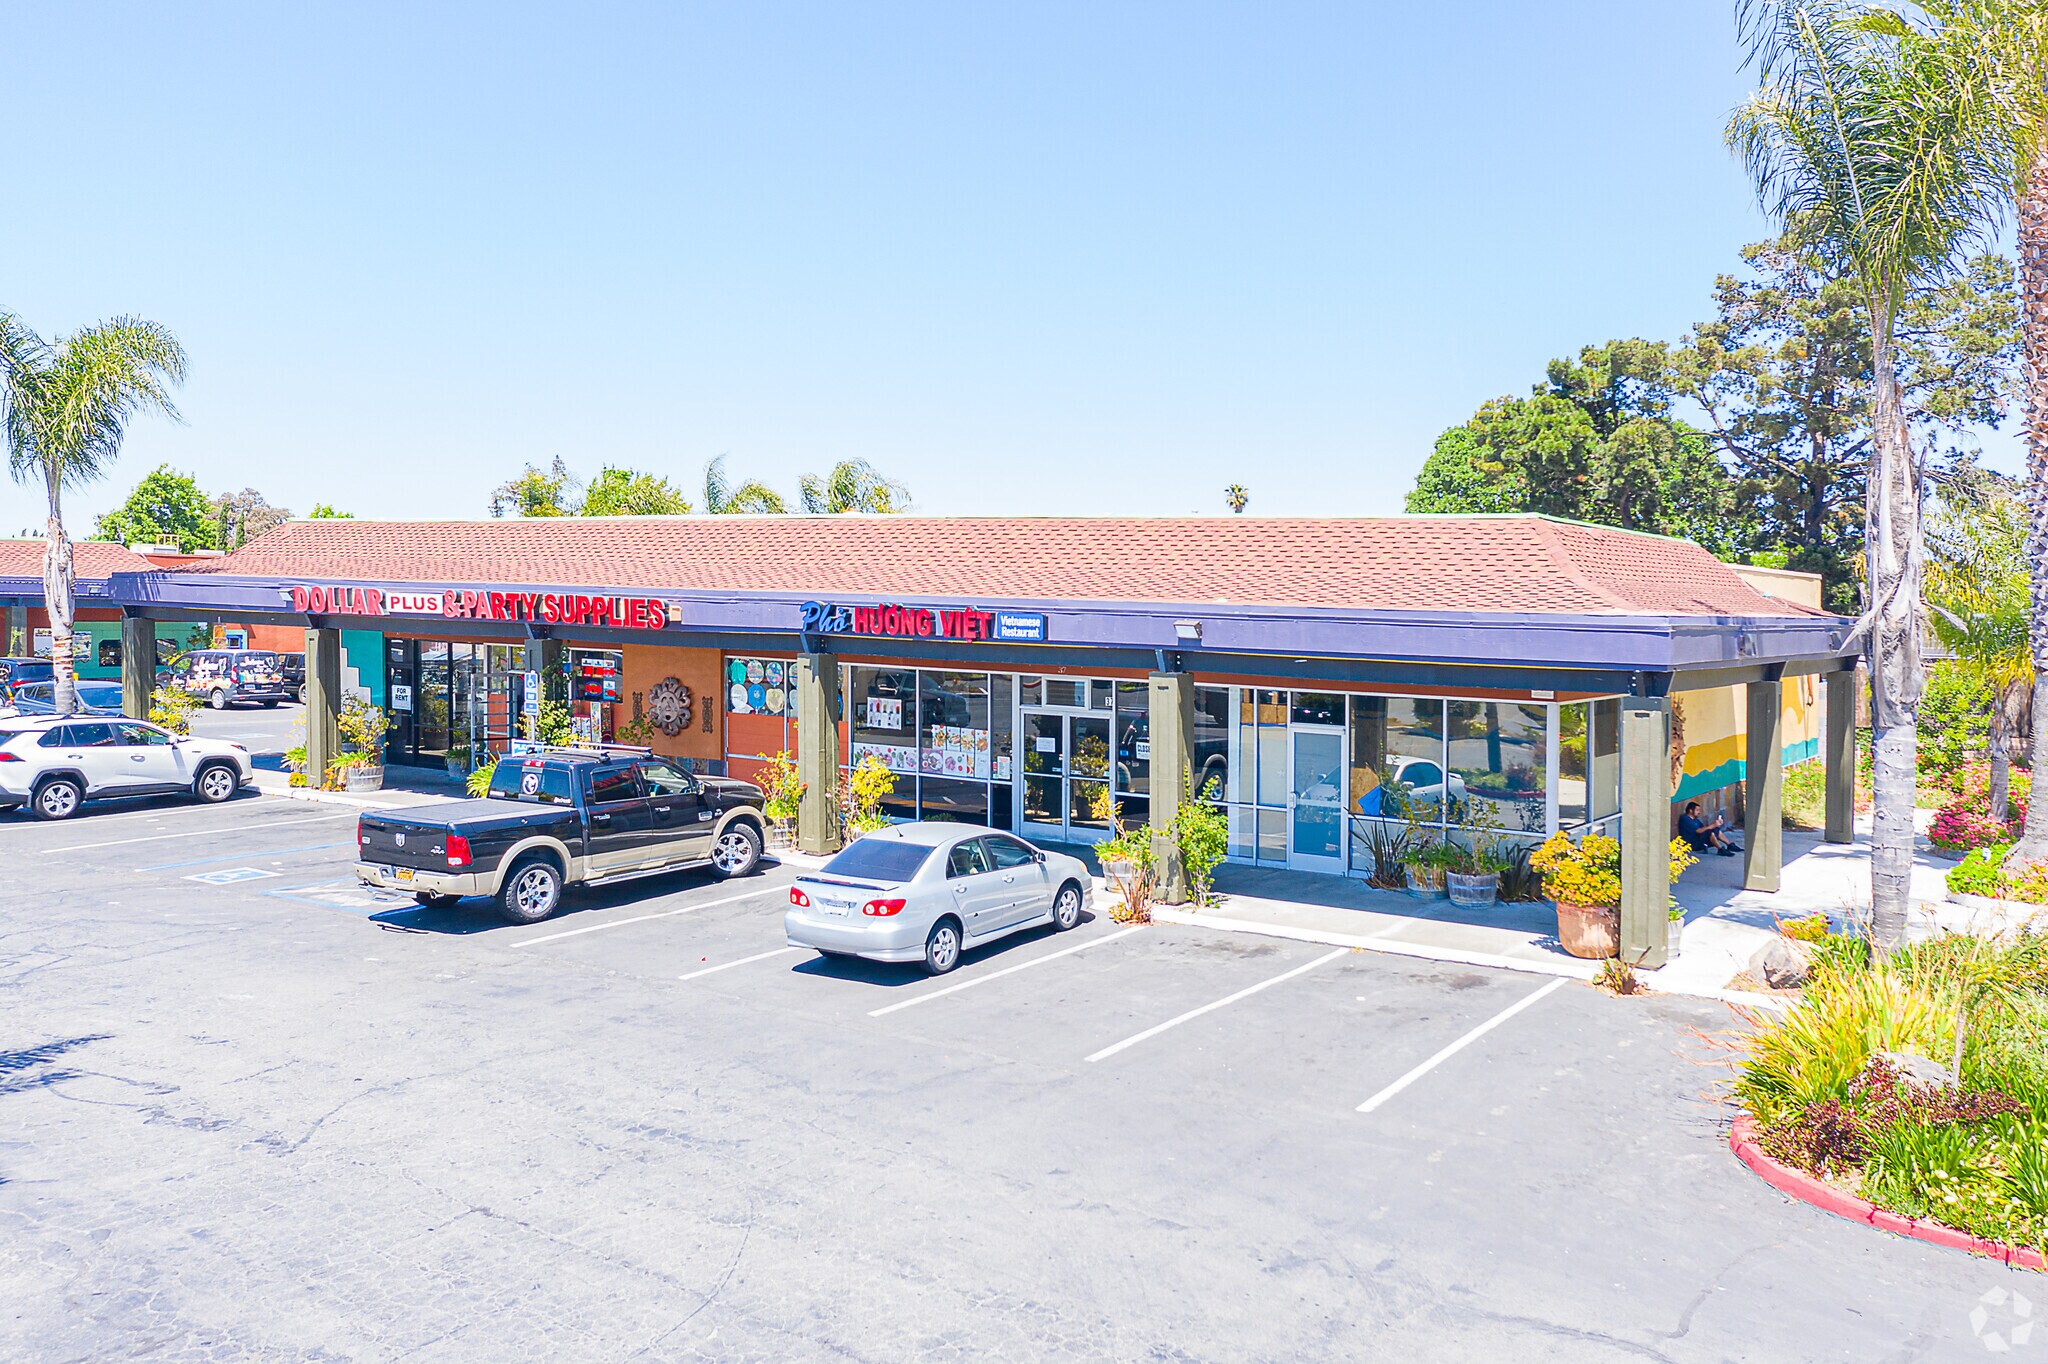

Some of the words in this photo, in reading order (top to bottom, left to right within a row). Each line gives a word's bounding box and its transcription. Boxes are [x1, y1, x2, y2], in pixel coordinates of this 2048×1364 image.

[293, 586, 385, 616] DOLLAR
[390, 596, 438, 611] PLUS
[543, 593, 666, 630] SUPPLIES
[1000, 615, 1041, 628] Vietnamese
[1001, 626, 1040, 638] Restaurant
[395, 694, 409, 702] RENT
